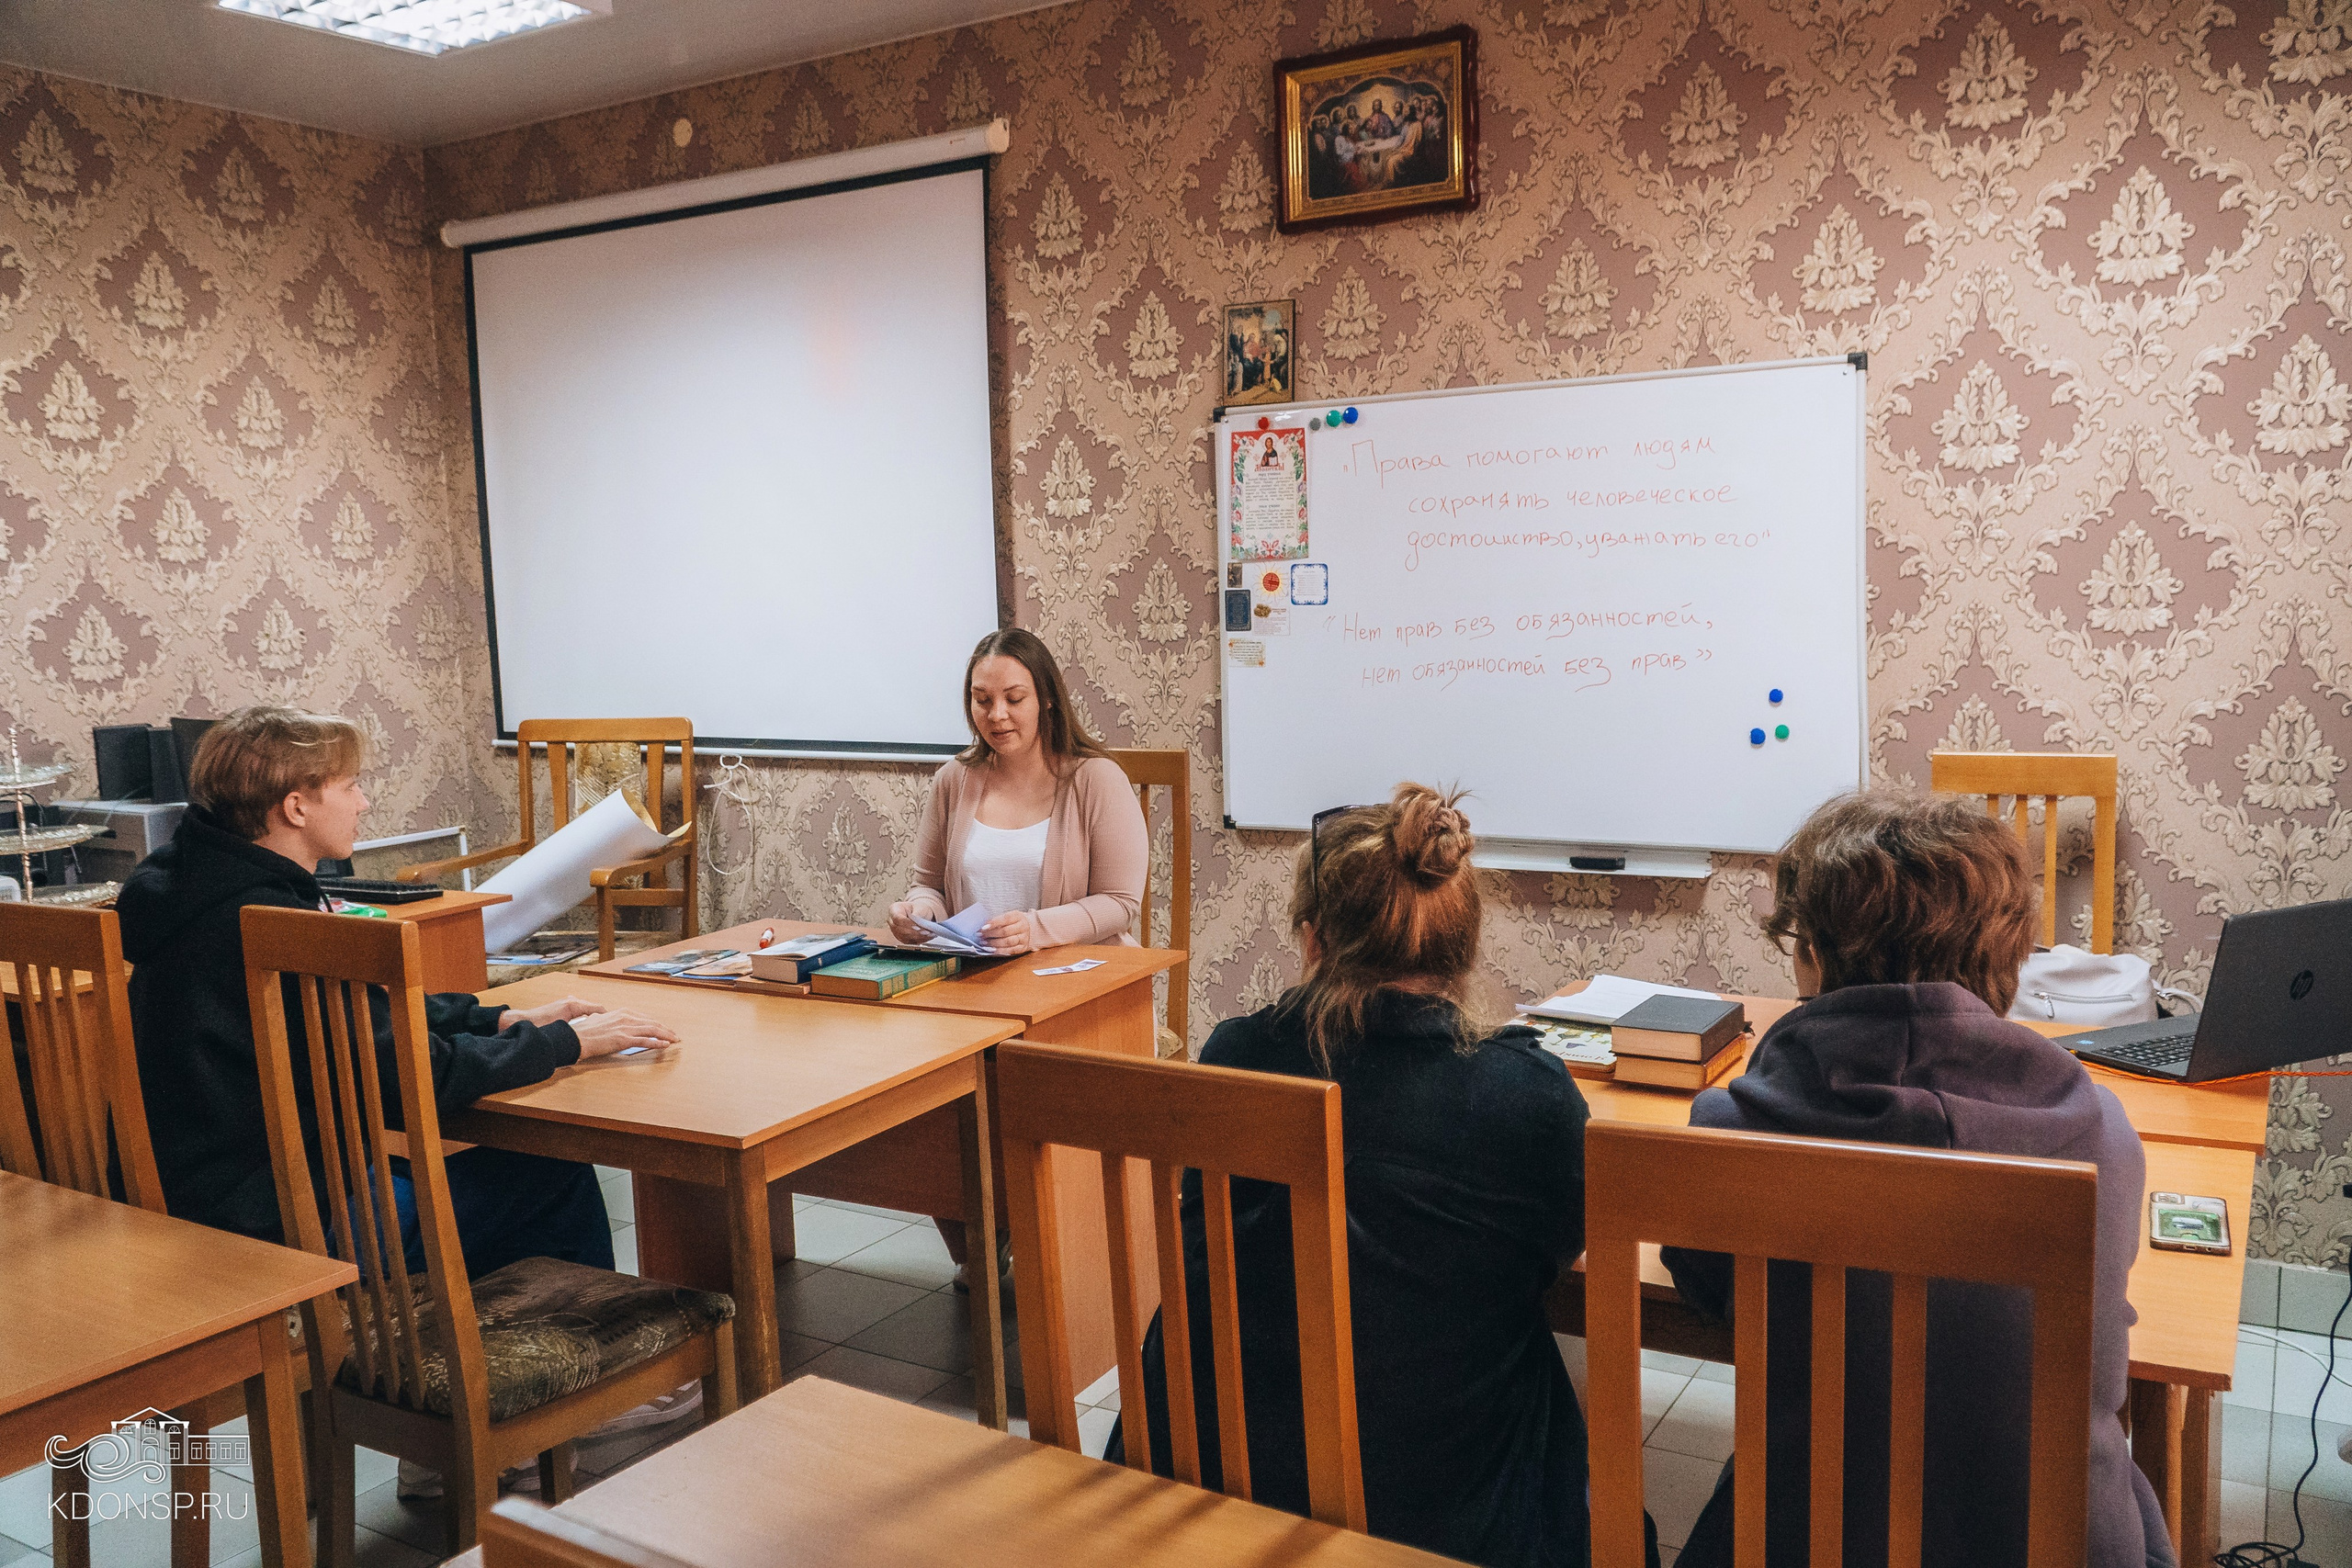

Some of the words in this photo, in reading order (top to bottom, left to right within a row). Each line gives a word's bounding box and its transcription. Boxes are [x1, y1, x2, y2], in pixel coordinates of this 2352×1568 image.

[1466, 446, 1609, 468] помогают
[1634, 436, 1716, 470] людям
[1408, 491, 1550, 518] сохранять
[1566, 484, 1738, 507] человеческое
[1396, 621, 1442, 648] прав
[1516, 603, 1713, 641] обязанностей,
[1362, 666, 1401, 689] нет
[1412, 654, 1546, 692] обязанностей
[2292, 971, 2312, 1001] hp
